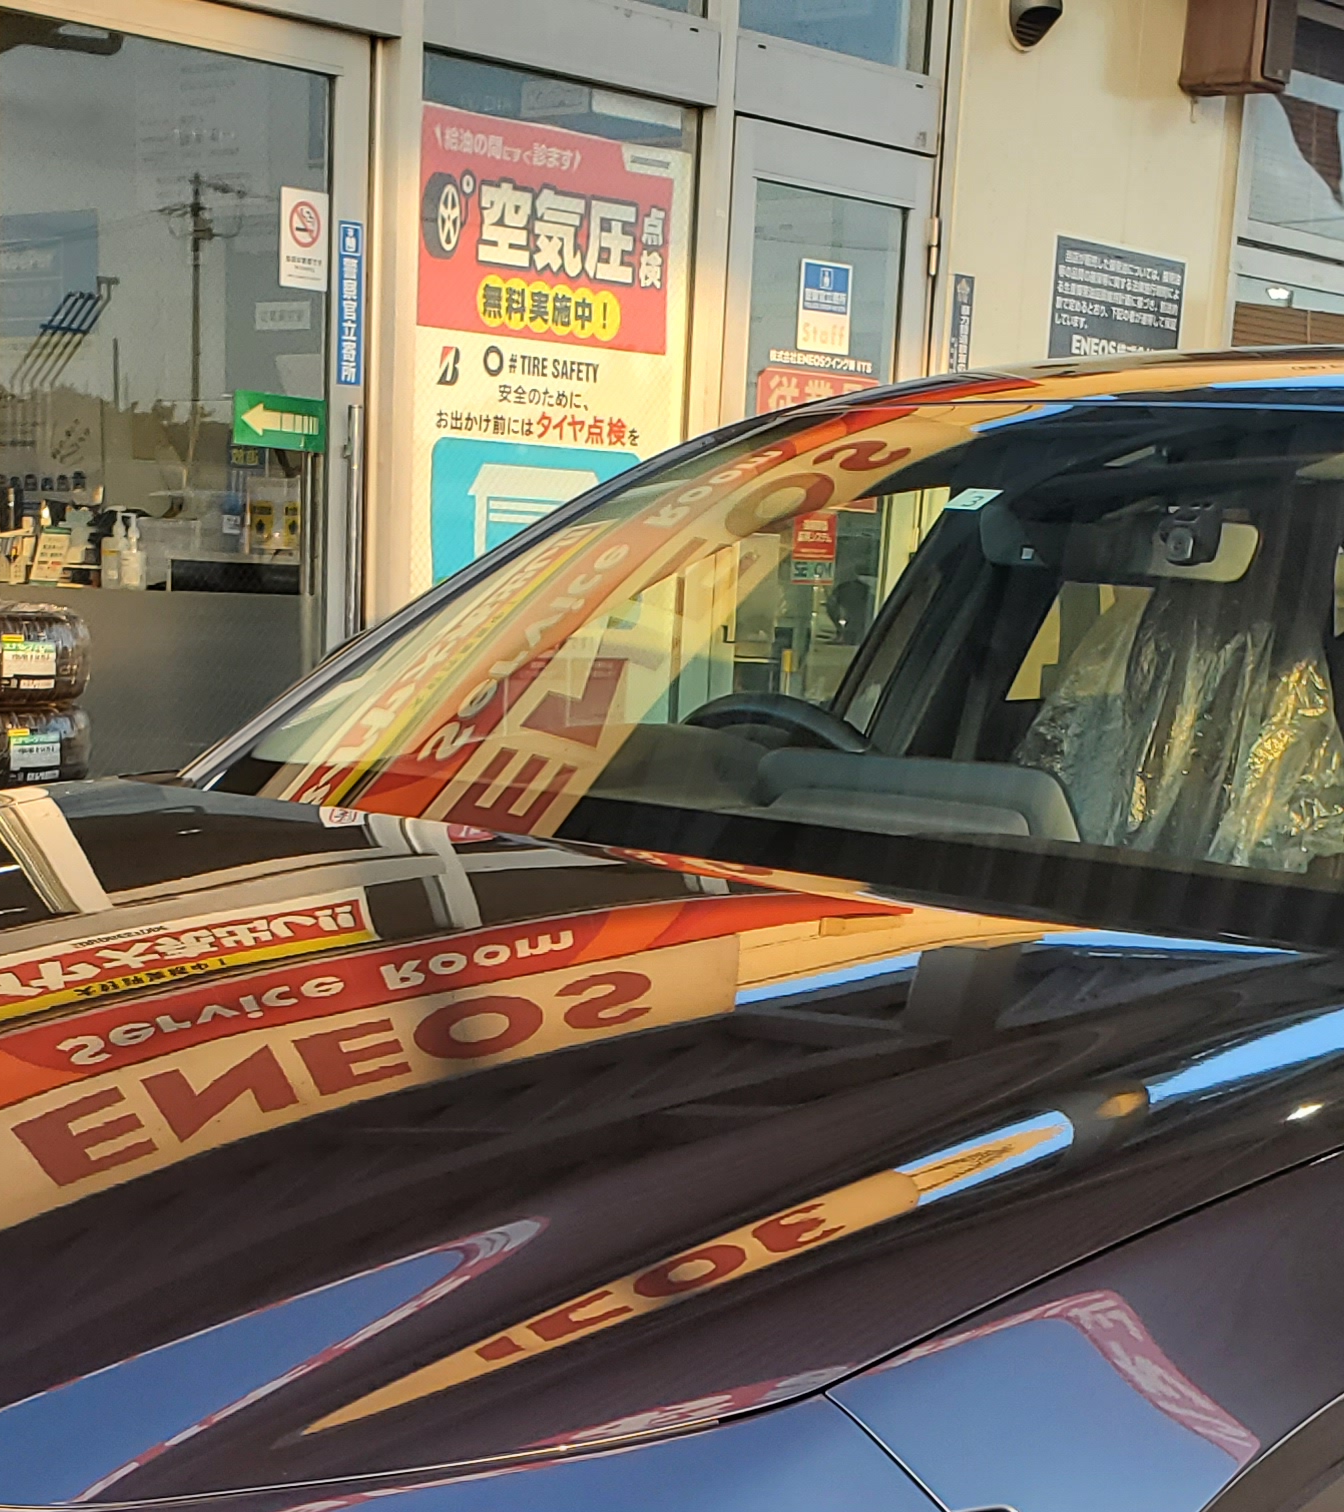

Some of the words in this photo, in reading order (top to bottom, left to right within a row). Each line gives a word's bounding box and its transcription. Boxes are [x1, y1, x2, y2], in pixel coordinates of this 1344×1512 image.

[477, 177, 639, 286] 空気圧
[638, 206, 666, 290] 点検
[802, 321, 846, 345] Staff
[551, 357, 600, 383] SAFETY
[498, 383, 590, 412] 安全のために、
[435, 409, 640, 447] お出かけ前にはタイヤ点検を
